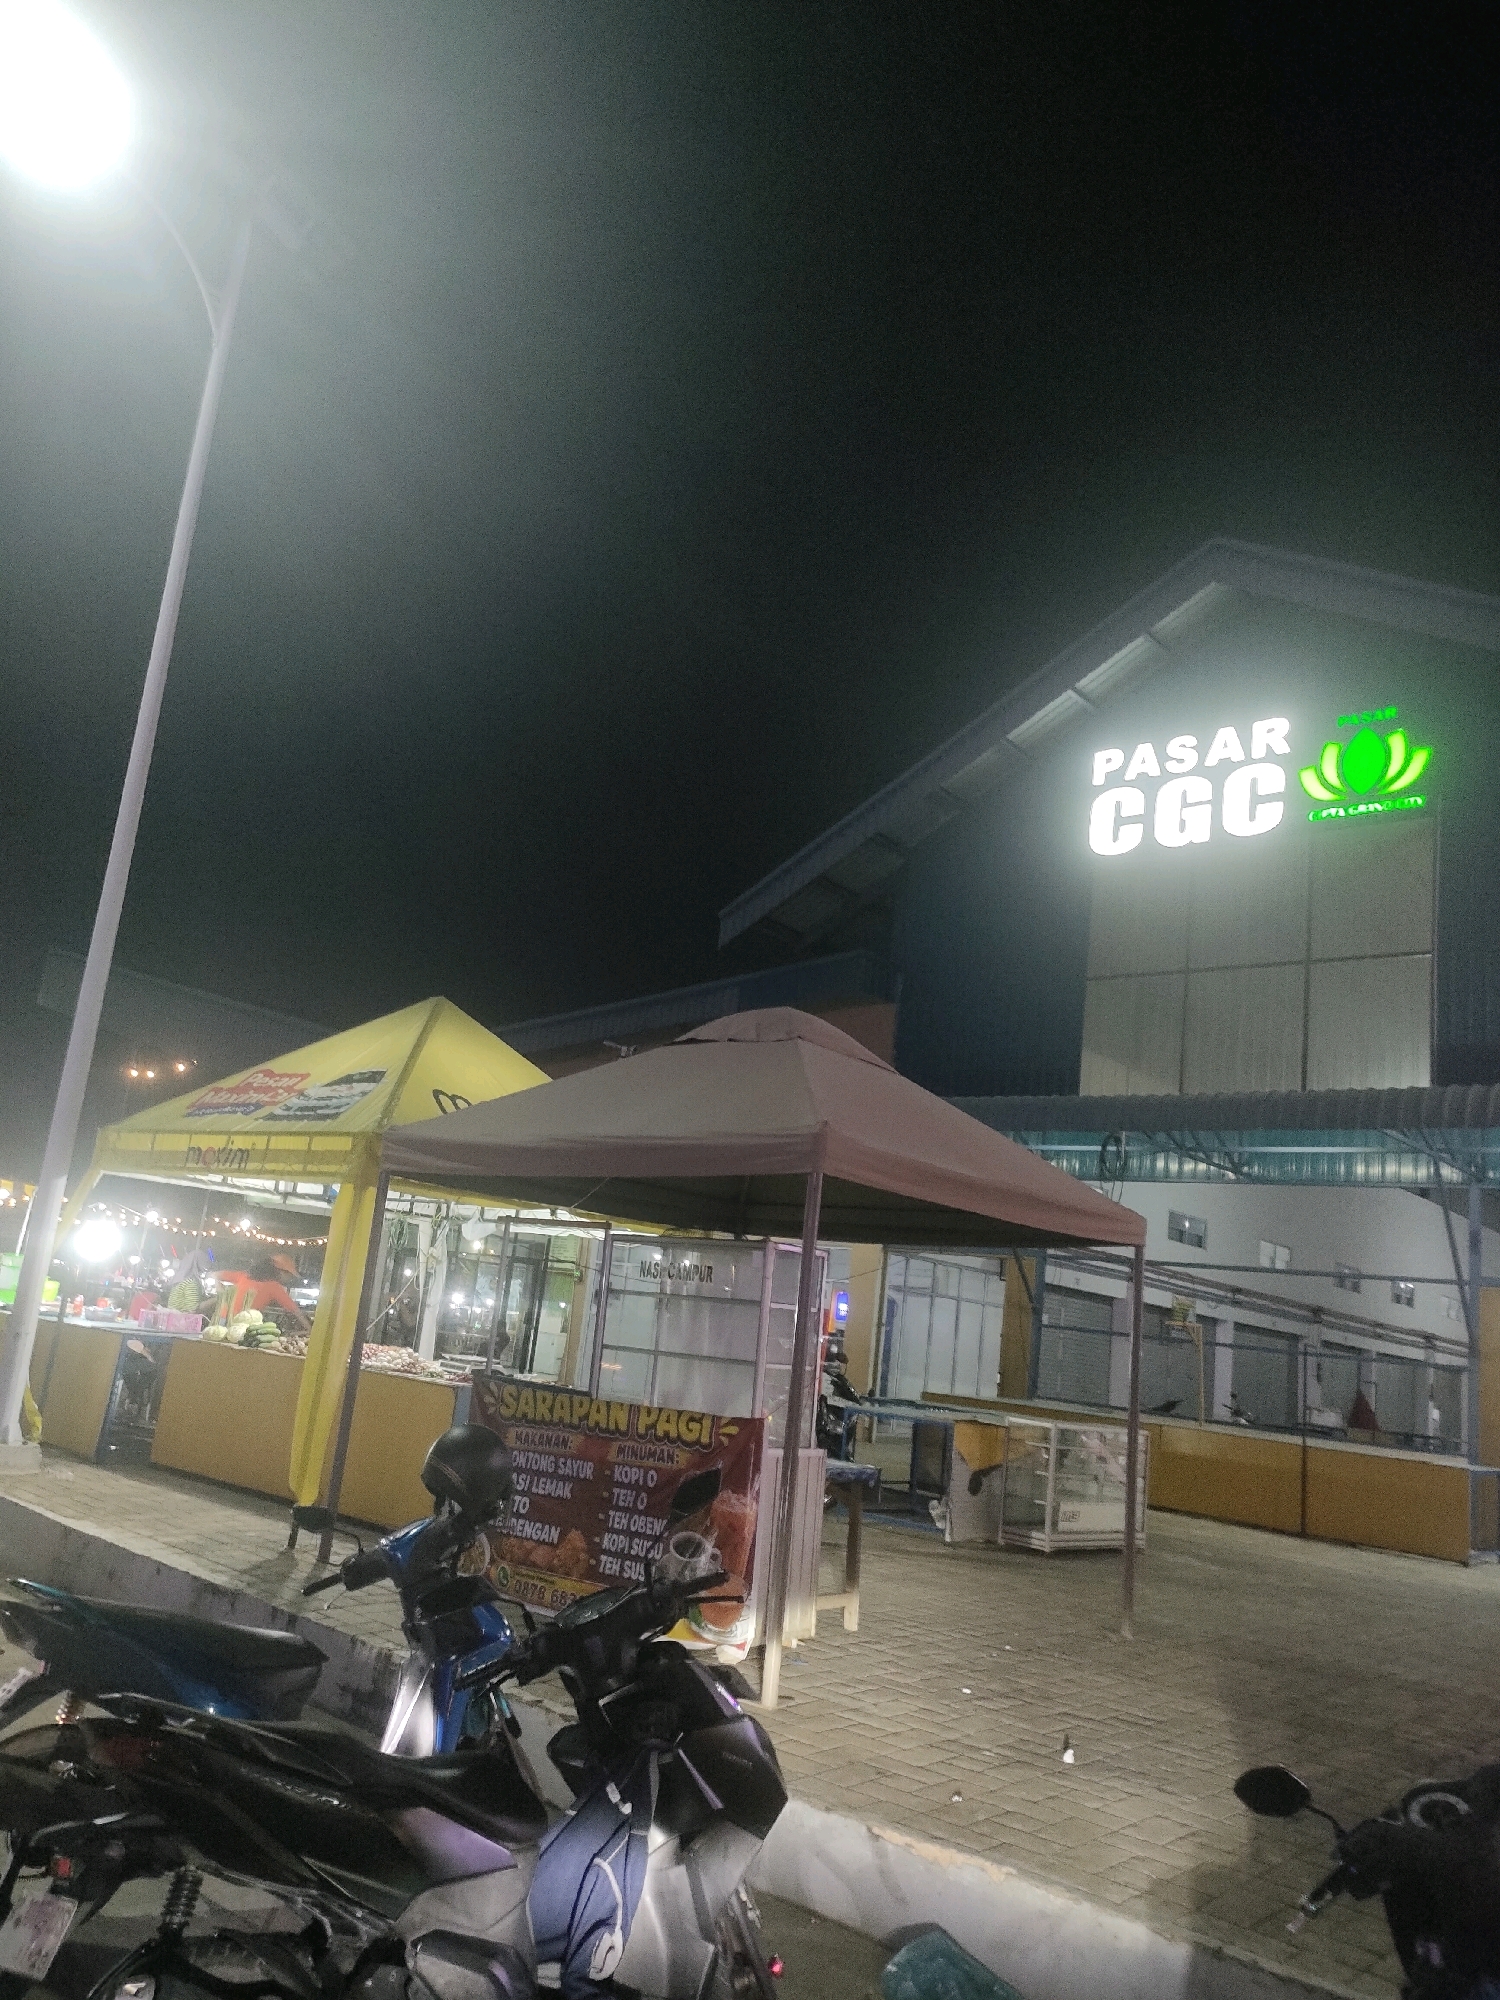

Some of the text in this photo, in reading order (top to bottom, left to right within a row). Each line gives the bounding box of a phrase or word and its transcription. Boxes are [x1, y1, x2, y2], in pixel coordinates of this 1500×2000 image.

[1337, 705, 1398, 729] PASAR
[1092, 716, 1292, 787] PASAR
[1088, 762, 1286, 856] CGC
[667, 1261, 714, 1283] CAMPUR
[500, 1383, 712, 1444] SARAPAN PAGI
[514, 1429, 573, 1450] MAKANAN:
[511, 1450, 595, 1480] ONTONG SAYUR
[616, 1442, 680, 1465] MINUMAN:
[531, 1475, 574, 1500] LEMAK
[614, 1464, 658, 1488] KOPI O
[612, 1487, 648, 1511] TEH O
[608, 1510, 630, 1530] TEH
[602, 1532, 628, 1555] KOPI
[598, 1554, 656, 1582] TEH SUS
